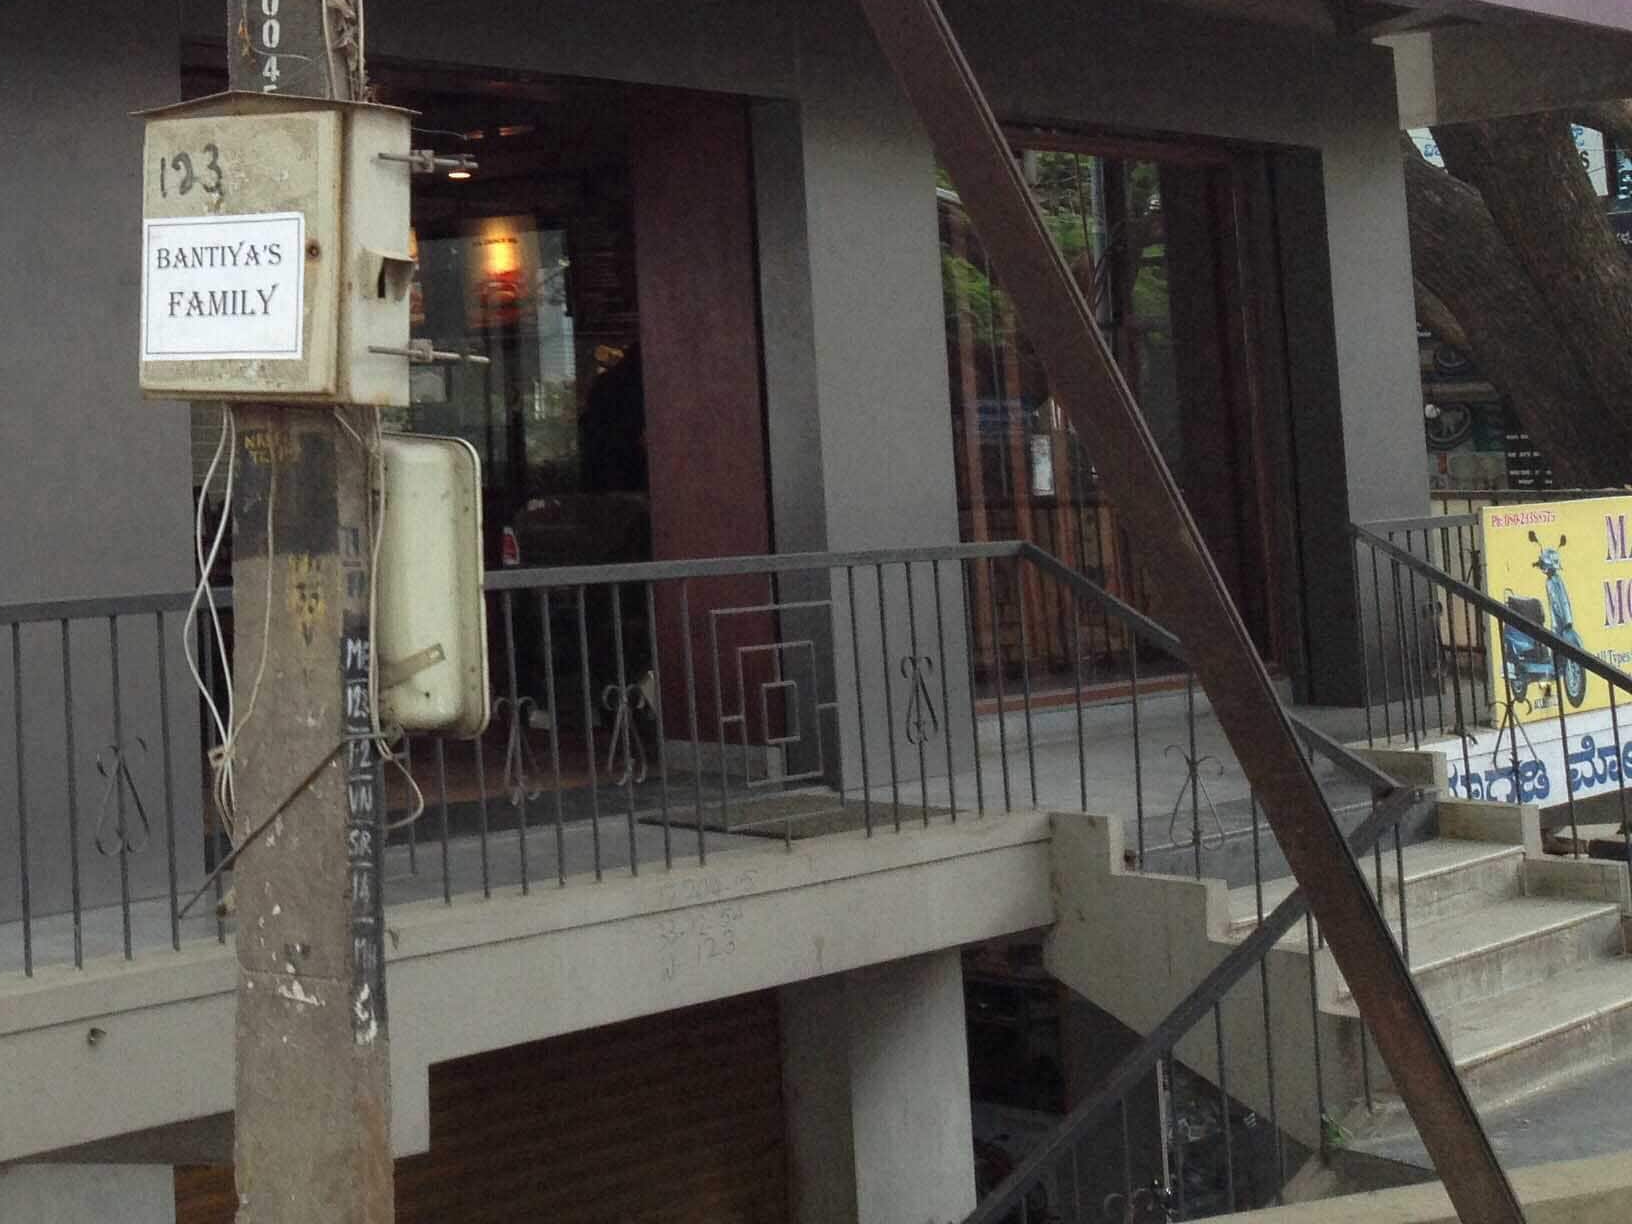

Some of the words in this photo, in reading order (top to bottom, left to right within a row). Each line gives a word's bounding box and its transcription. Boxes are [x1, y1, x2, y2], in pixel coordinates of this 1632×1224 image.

[160, 144, 224, 198] 123
[157, 241, 282, 269] BANTIYA'S
[168, 283, 280, 316] FAMILY
